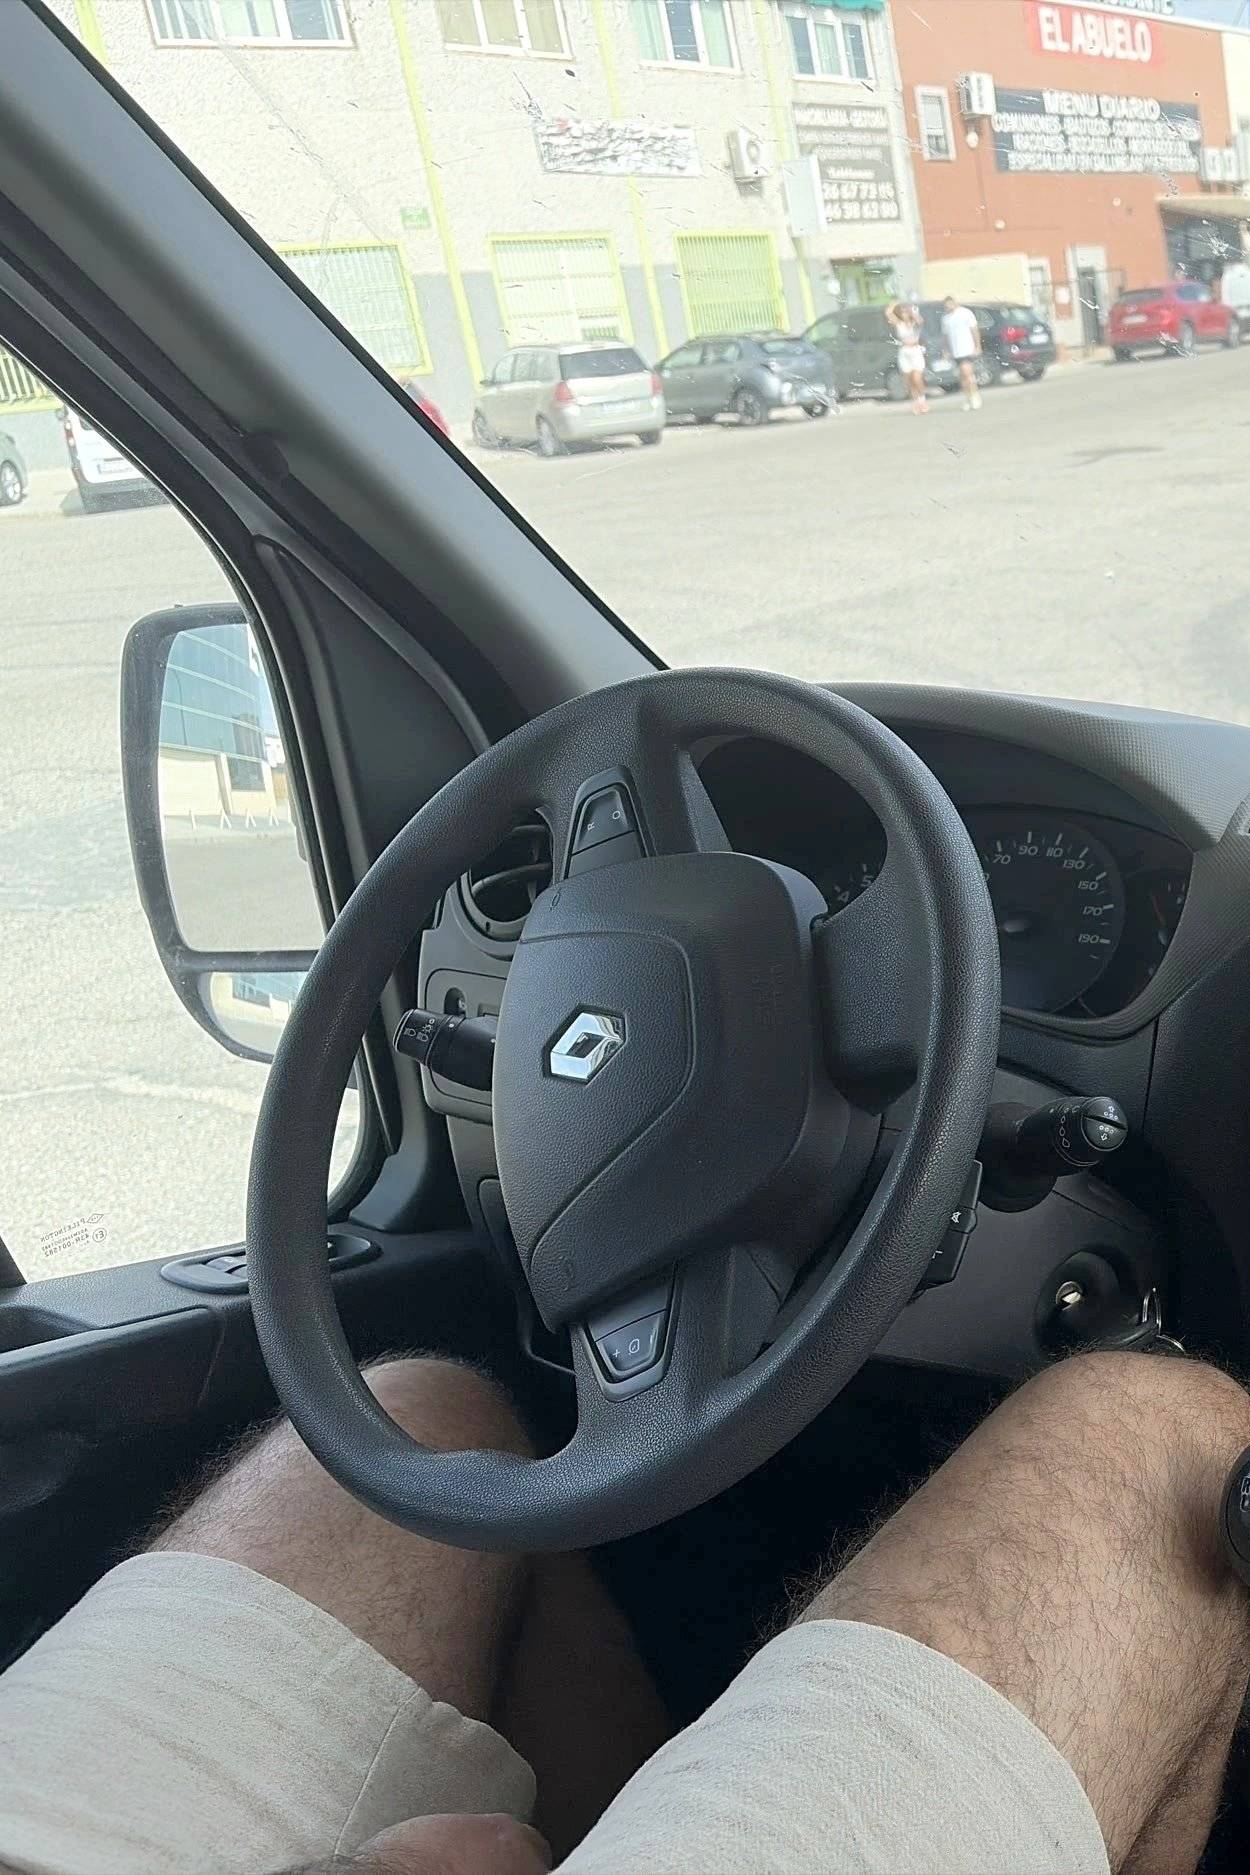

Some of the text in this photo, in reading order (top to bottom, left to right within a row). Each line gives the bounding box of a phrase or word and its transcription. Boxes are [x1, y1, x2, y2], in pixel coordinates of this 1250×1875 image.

[1038, 6, 1153, 63] EL ABUELO
[1019, 845, 1038, 856] 90
[1046, 848, 1063, 858] 110
[992, 854, 1011, 865] 70
[1063, 860, 1085, 870] 130
[1078, 880, 1099, 891] 150
[1082, 906, 1102, 916] 170
[1078, 934, 1099, 944] 190
